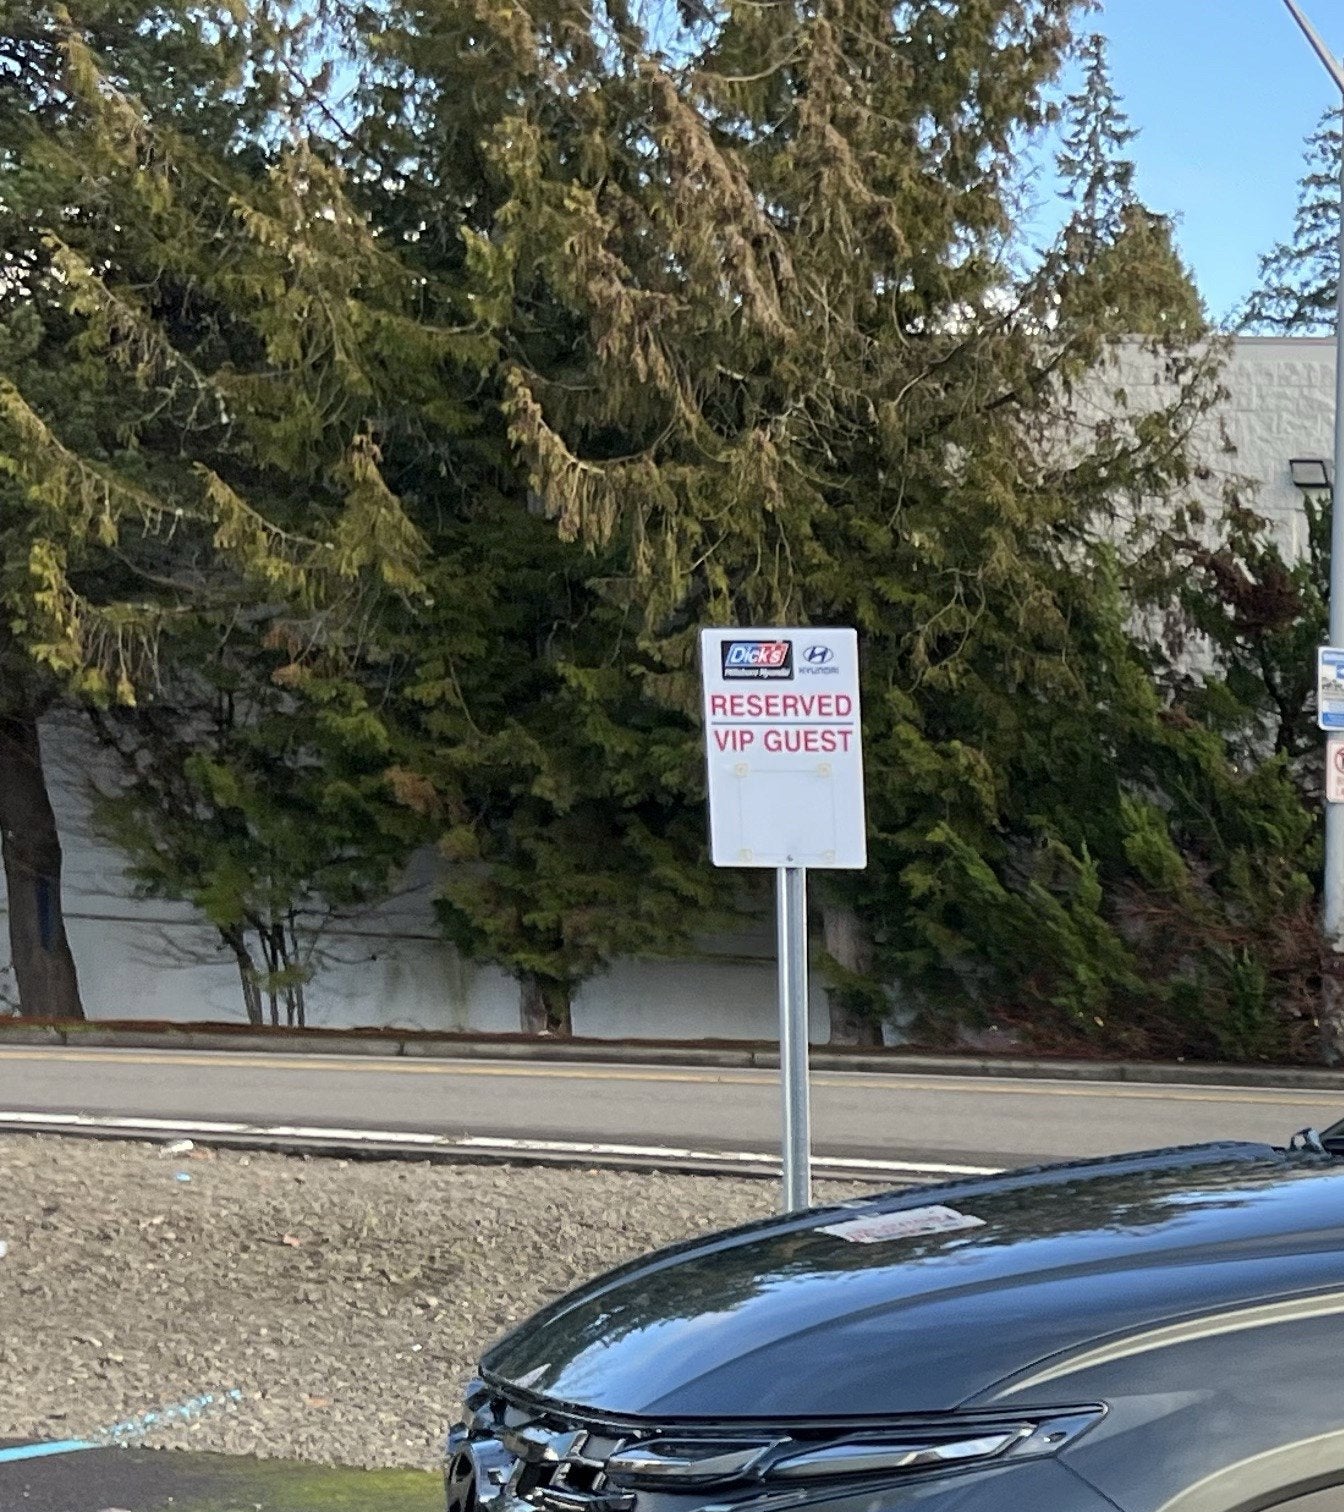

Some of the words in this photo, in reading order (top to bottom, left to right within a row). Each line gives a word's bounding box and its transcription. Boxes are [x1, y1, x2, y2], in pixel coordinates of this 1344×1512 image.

[730, 644, 782, 664] Dick's
[711, 694, 852, 717] RESERVED
[714, 730, 754, 752] VIP
[764, 730, 853, 752] GUEST
